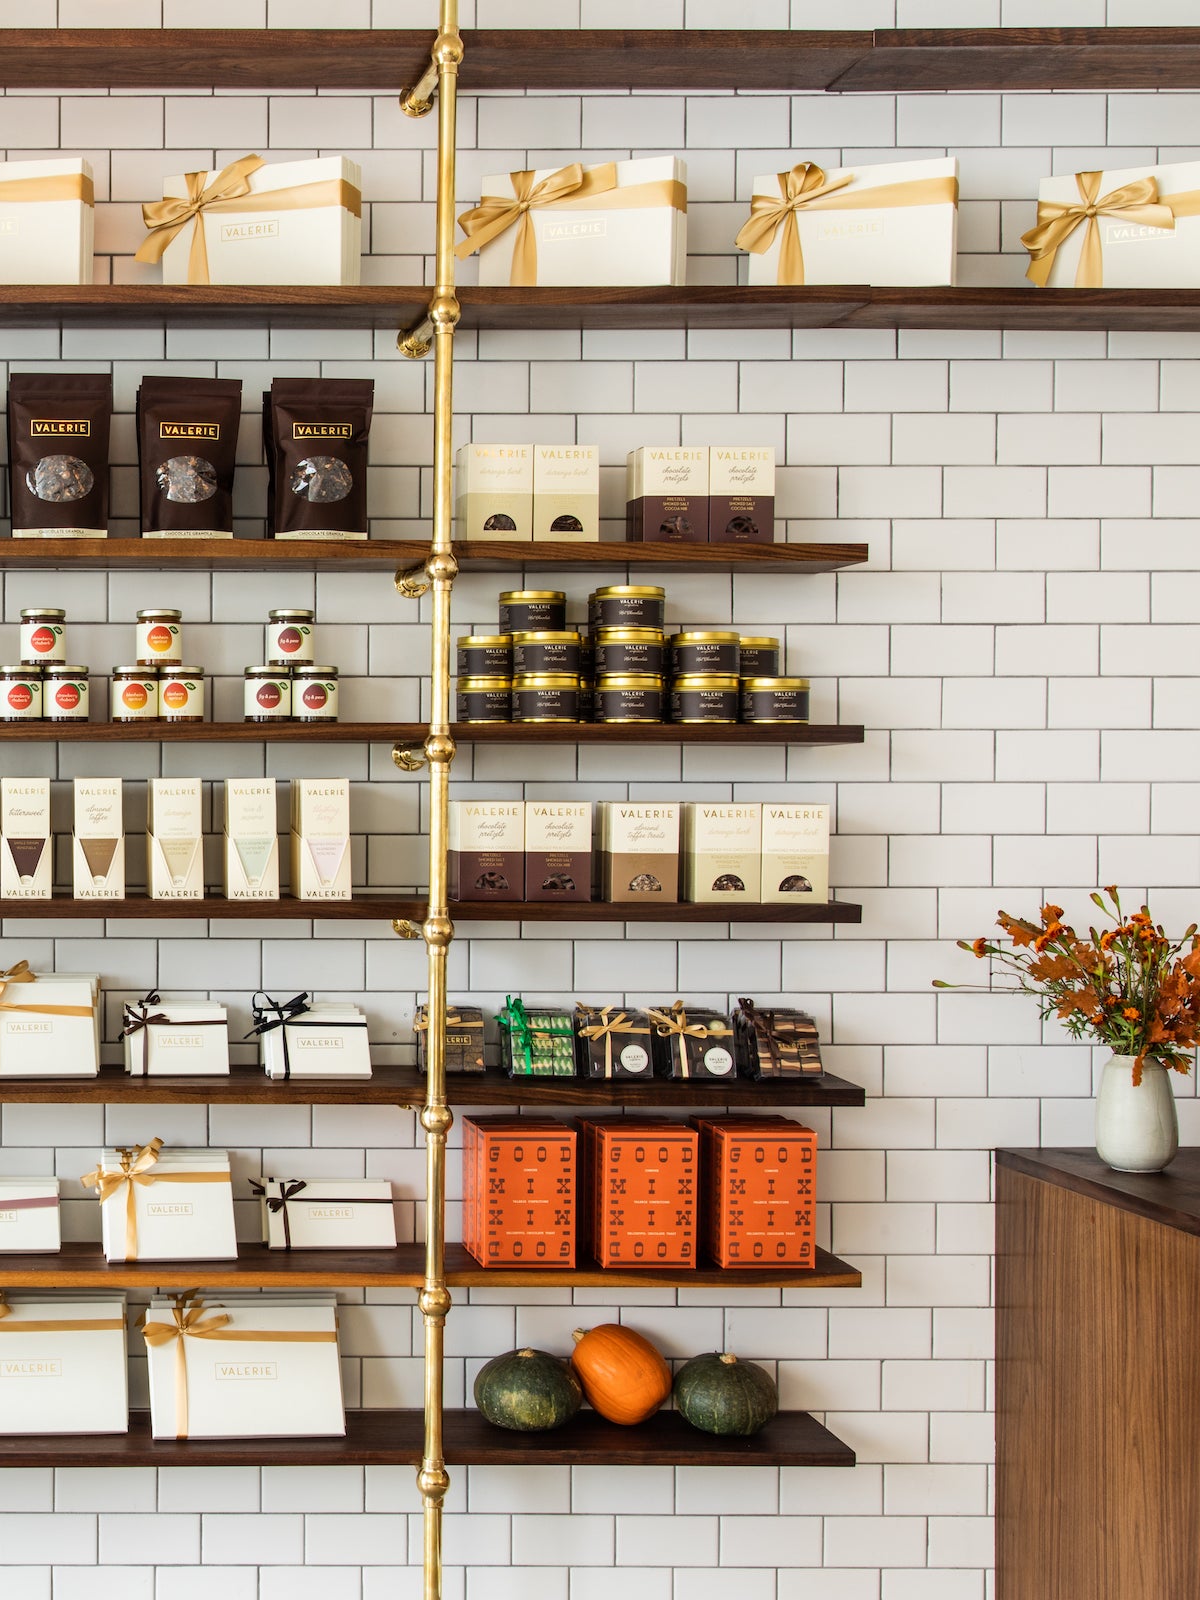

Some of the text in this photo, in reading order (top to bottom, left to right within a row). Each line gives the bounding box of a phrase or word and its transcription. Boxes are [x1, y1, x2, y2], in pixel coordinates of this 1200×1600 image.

[225, 223, 274, 237] VALERIE
[549, 223, 602, 237] VALERIE
[823, 222, 881, 236] VALERIE
[35, 423, 86, 433] VALERIE
[164, 426, 216, 437] VALERIE
[297, 426, 349, 436] VALERIE
[475, 449, 527, 459] VALERIE
[541, 449, 593, 459] VALERIE
[651, 452, 702, 462] VALERIE
[717, 452, 769, 462] VALERIE
[662, 465, 692, 475] chocolate
[728, 465, 758, 475] chocolate
[7, 788, 46, 796] VALERIE
[79, 788, 117, 796] VALERIE
[159, 788, 196, 796] VALERIE
[8, 808, 45, 817] bittersweet
[465, 808, 518, 817] VALERIE
[532, 808, 585, 817] VALERIE
[620, 810, 673, 818] VALERIE
[703, 809, 757, 818] VALERIE
[770, 810, 824, 819] VALERIE
[477, 821, 505, 830] chocolate
[544, 821, 573, 830] chocolate
[6, 889, 46, 897] VALERIE
[10, 1023, 49, 1032] VALERIE
[161, 1036, 201, 1045] VALERIE
[300, 1039, 340, 1047] VALERIE
[488, 1146, 570, 1162] GOOD
[610, 1146, 692, 1162] GOOD
[729, 1147, 812, 1163] GOOD
[151, 1205, 190, 1213] VALERIE
[311, 1209, 349, 1217] VALERIE
[6, 1363, 57, 1373] VALERIE
[221, 1366, 272, 1376] VALERIE
